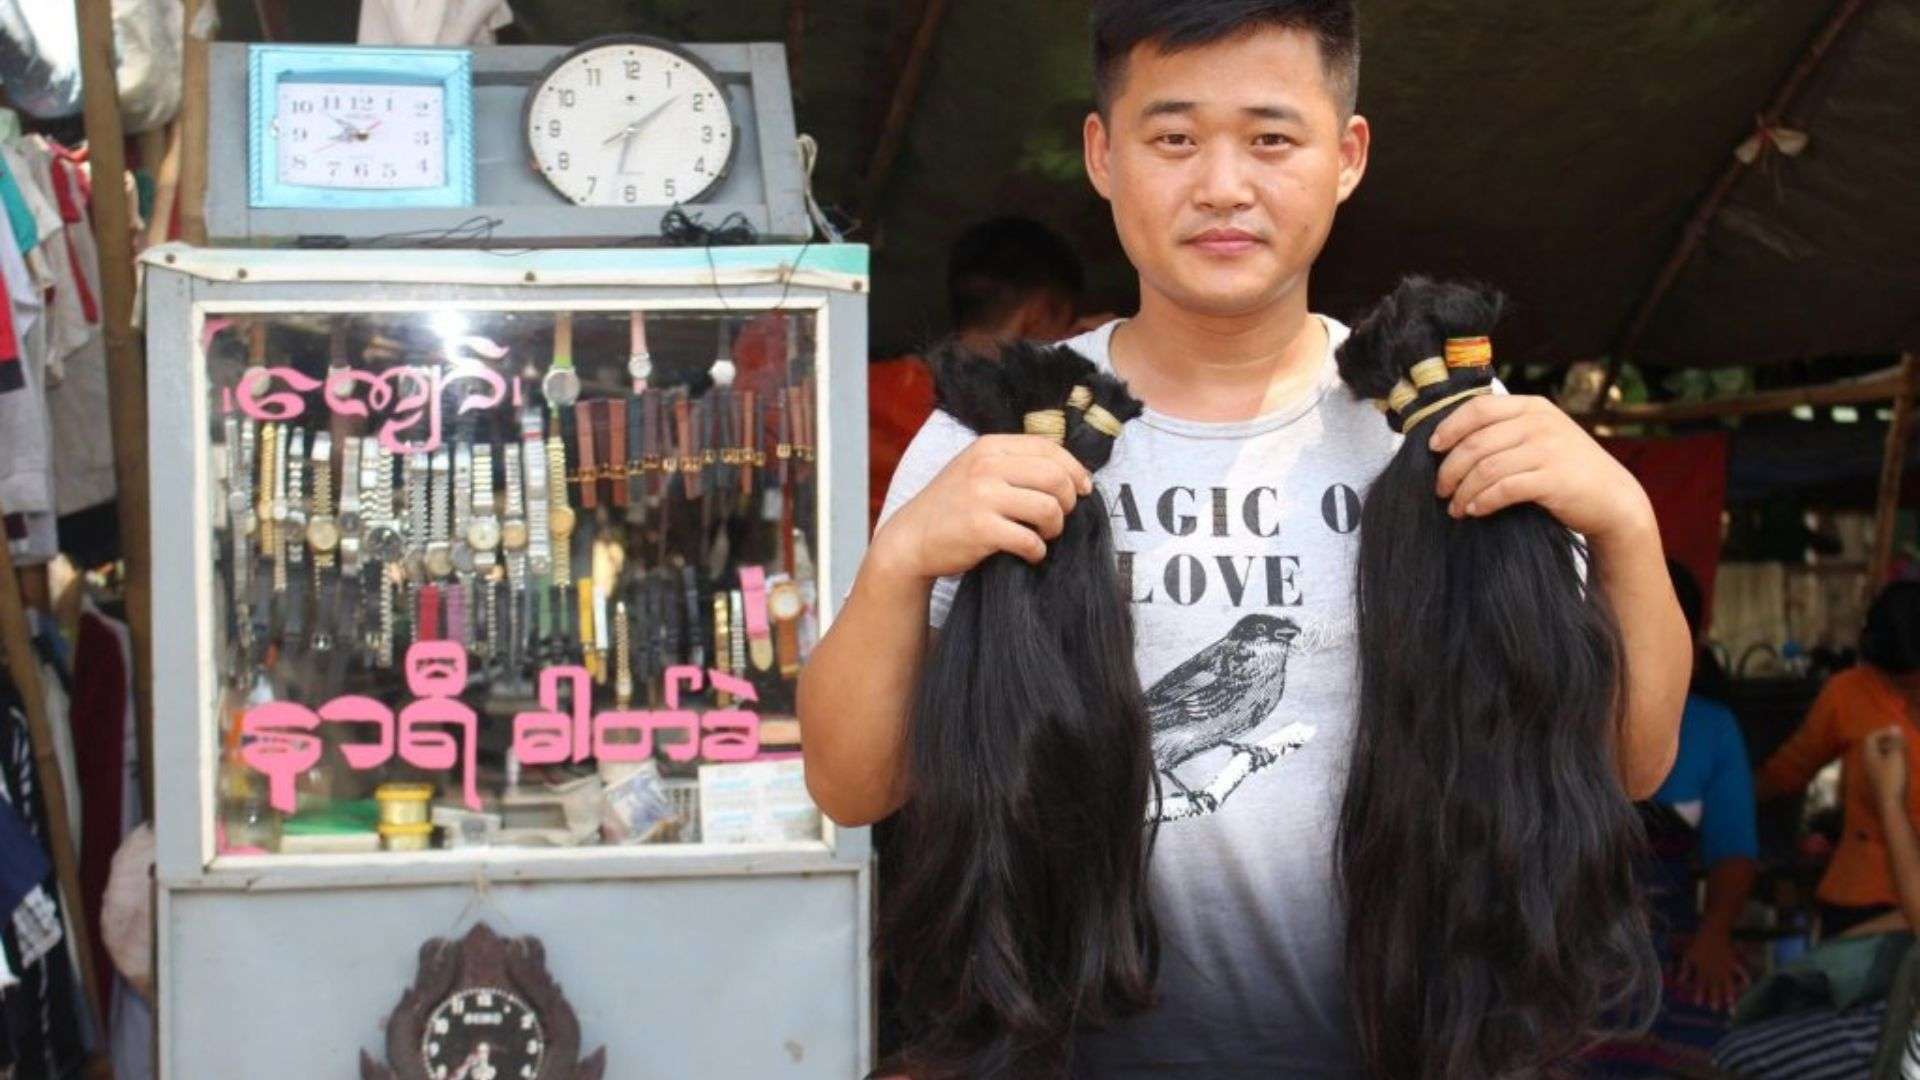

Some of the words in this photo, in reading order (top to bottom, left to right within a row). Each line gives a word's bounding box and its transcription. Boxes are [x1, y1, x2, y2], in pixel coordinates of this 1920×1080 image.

[585, 67, 601, 87] 11
[623, 59, 640, 80] 12
[664, 70, 673, 88] 1
[291, 100, 314, 114] 10
[323, 95, 340, 110] 11
[350, 96, 374, 111] 12
[386, 97, 393, 112] 1
[558, 88, 576, 108] 10
[692, 92, 704, 112] 2
[414, 102, 430, 117] 2
[292, 127, 308, 142] 9
[549, 119, 561, 138] 9
[701, 125, 713, 144] 3
[414, 130, 430, 146] 3
[292, 155, 308, 170] 8
[327, 161, 341, 177] 7
[381, 162, 398, 178] 5
[418, 157, 429, 173] 4
[558, 152, 570, 170] 8
[693, 157, 705, 174] 4
[353, 163, 369, 178] 6
[587, 176, 598, 195] 7
[623, 184, 637, 203] 6
[663, 178, 676, 197] 5
[1107, 482, 1280, 537] AGIC
[1321, 482, 1362, 535] O
[1116, 551, 1304, 608] LOVE
[241, 640, 482, 814] နာရီ
